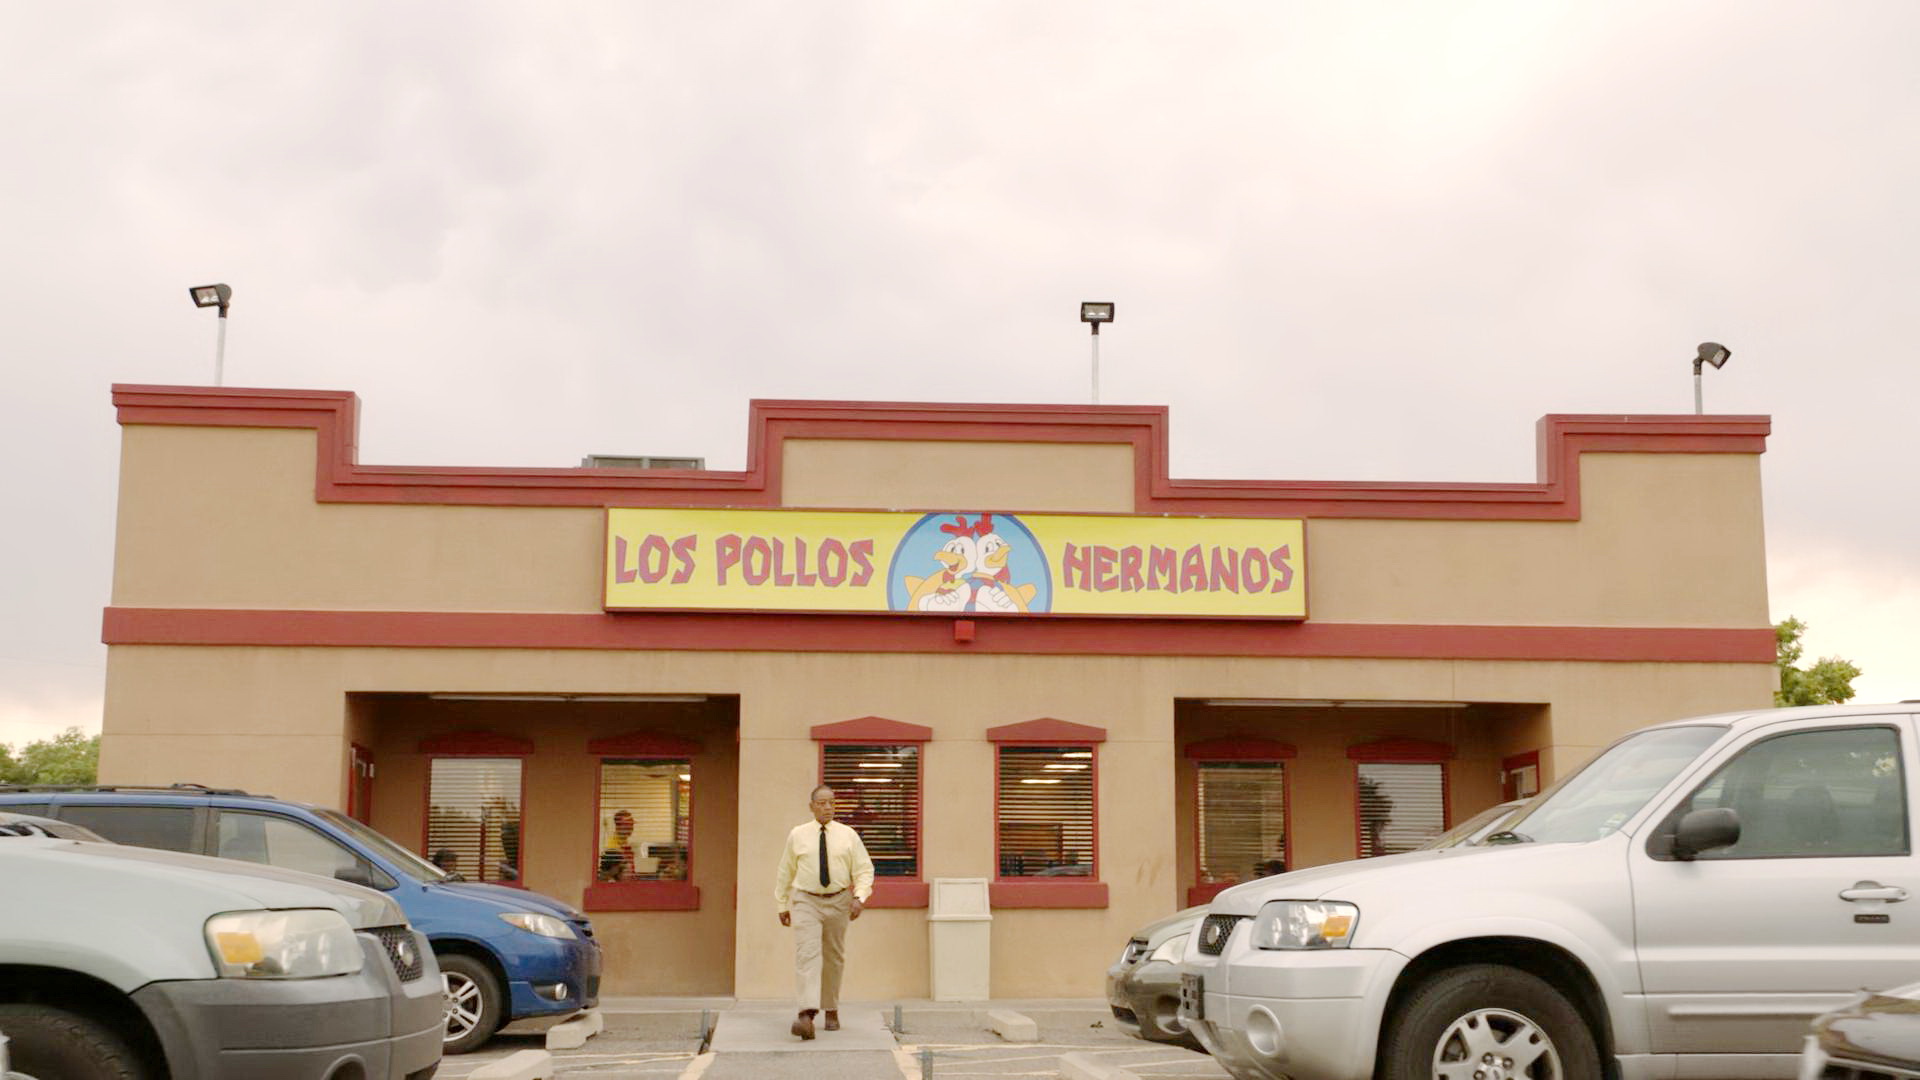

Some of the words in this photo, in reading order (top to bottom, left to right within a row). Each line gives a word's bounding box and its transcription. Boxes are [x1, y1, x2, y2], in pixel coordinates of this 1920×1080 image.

[615, 534, 697, 584] LOS
[715, 533, 874, 588] POLLOS
[1063, 542, 1294, 594] HERMANOS
